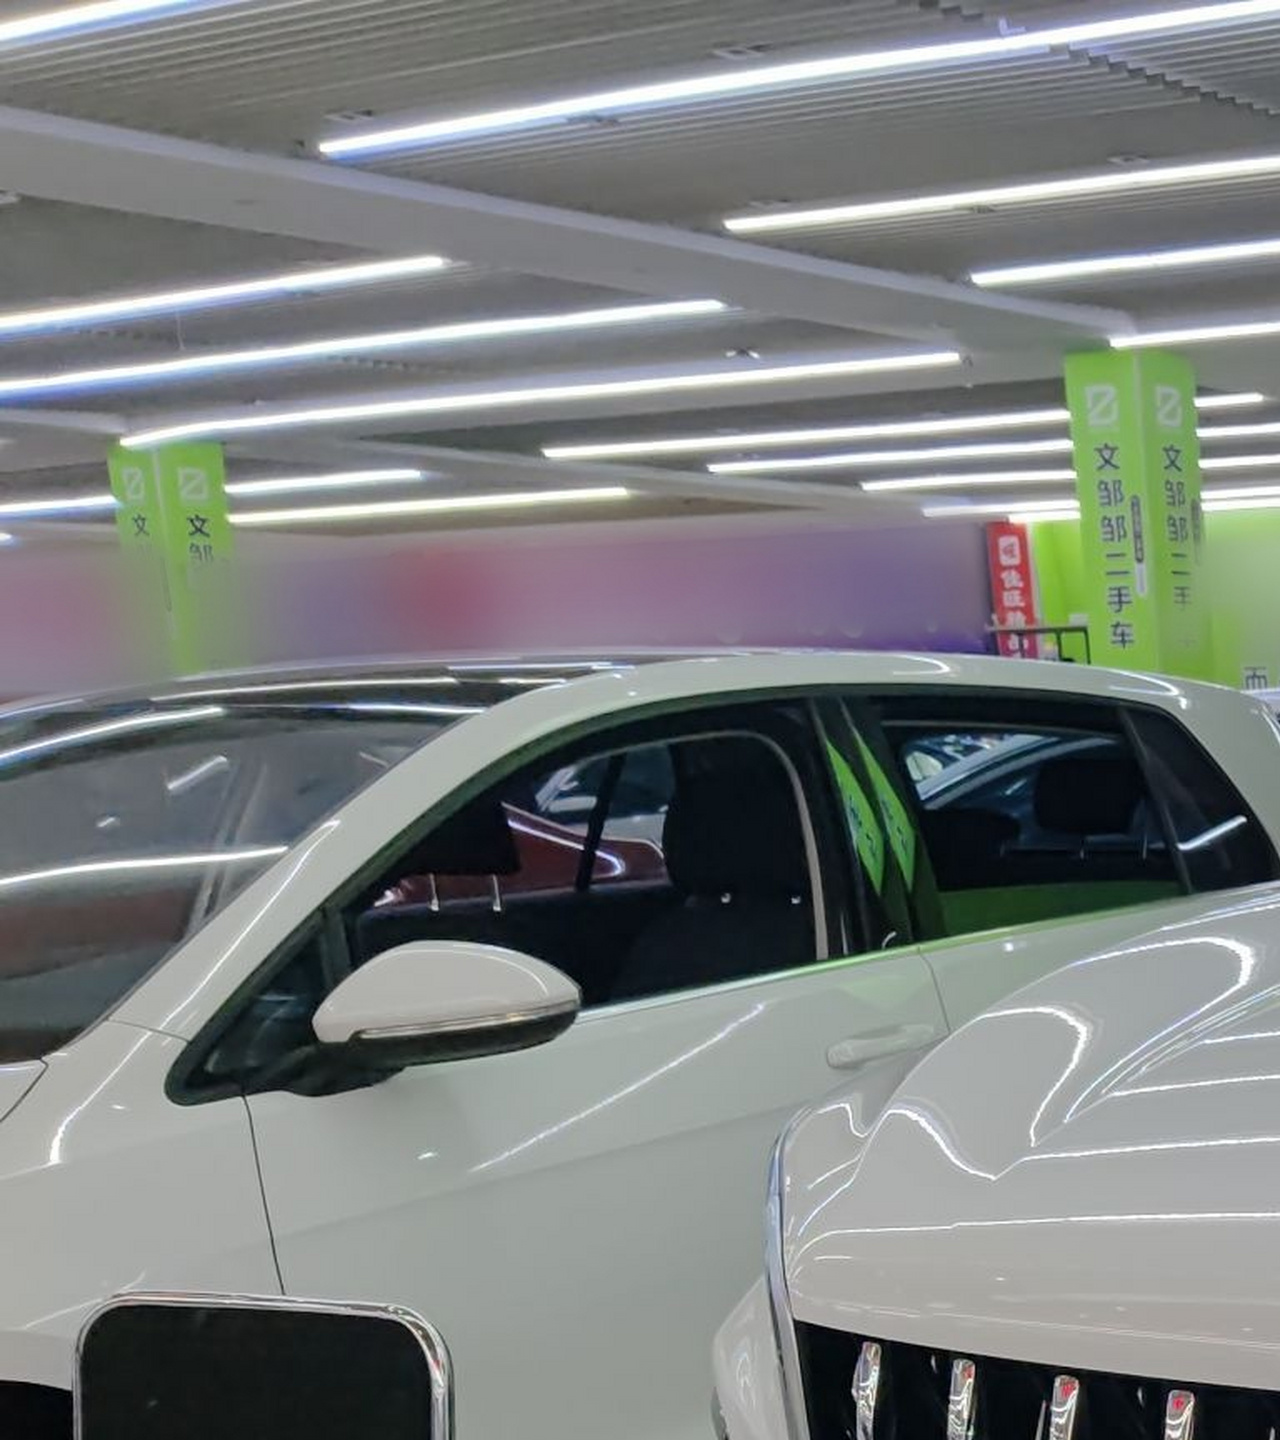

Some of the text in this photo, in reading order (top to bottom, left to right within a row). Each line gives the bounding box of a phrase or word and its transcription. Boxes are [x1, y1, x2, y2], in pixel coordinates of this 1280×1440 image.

[1094, 442, 1135, 649] 文邹邹二手车
